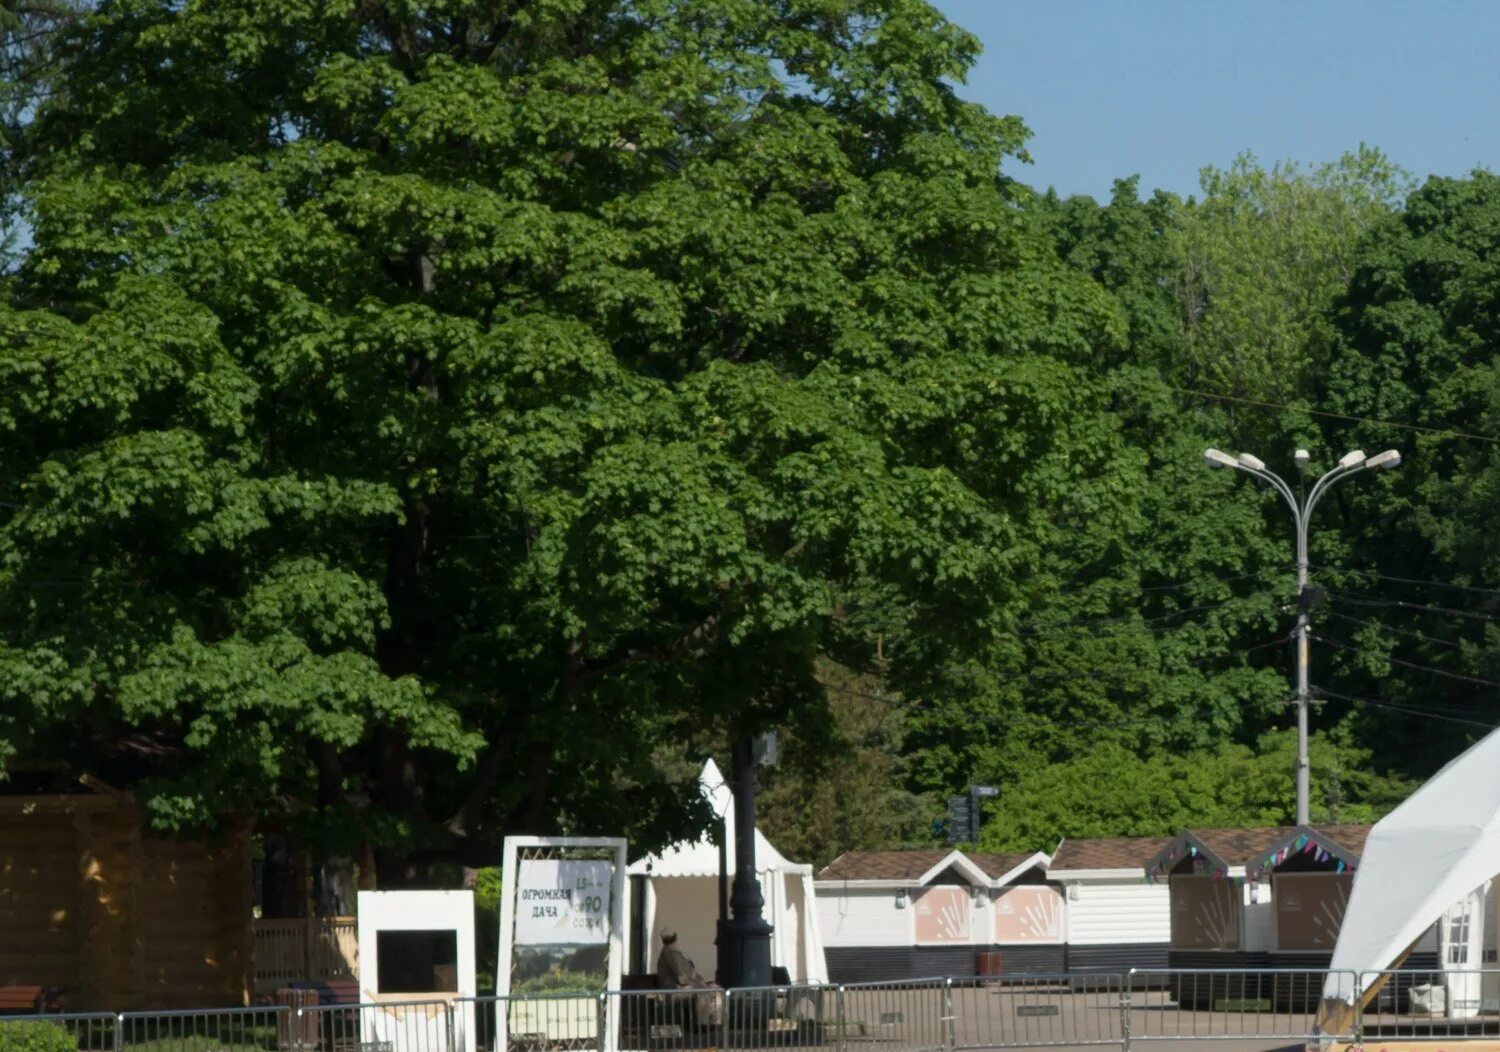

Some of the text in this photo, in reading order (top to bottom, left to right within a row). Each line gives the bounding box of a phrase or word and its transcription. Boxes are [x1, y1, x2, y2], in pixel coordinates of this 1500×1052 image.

[522, 889, 572, 901] ОГРОМНАЯ
[585, 896, 602, 913] 90
[532, 907, 558, 917] ДАЧА
